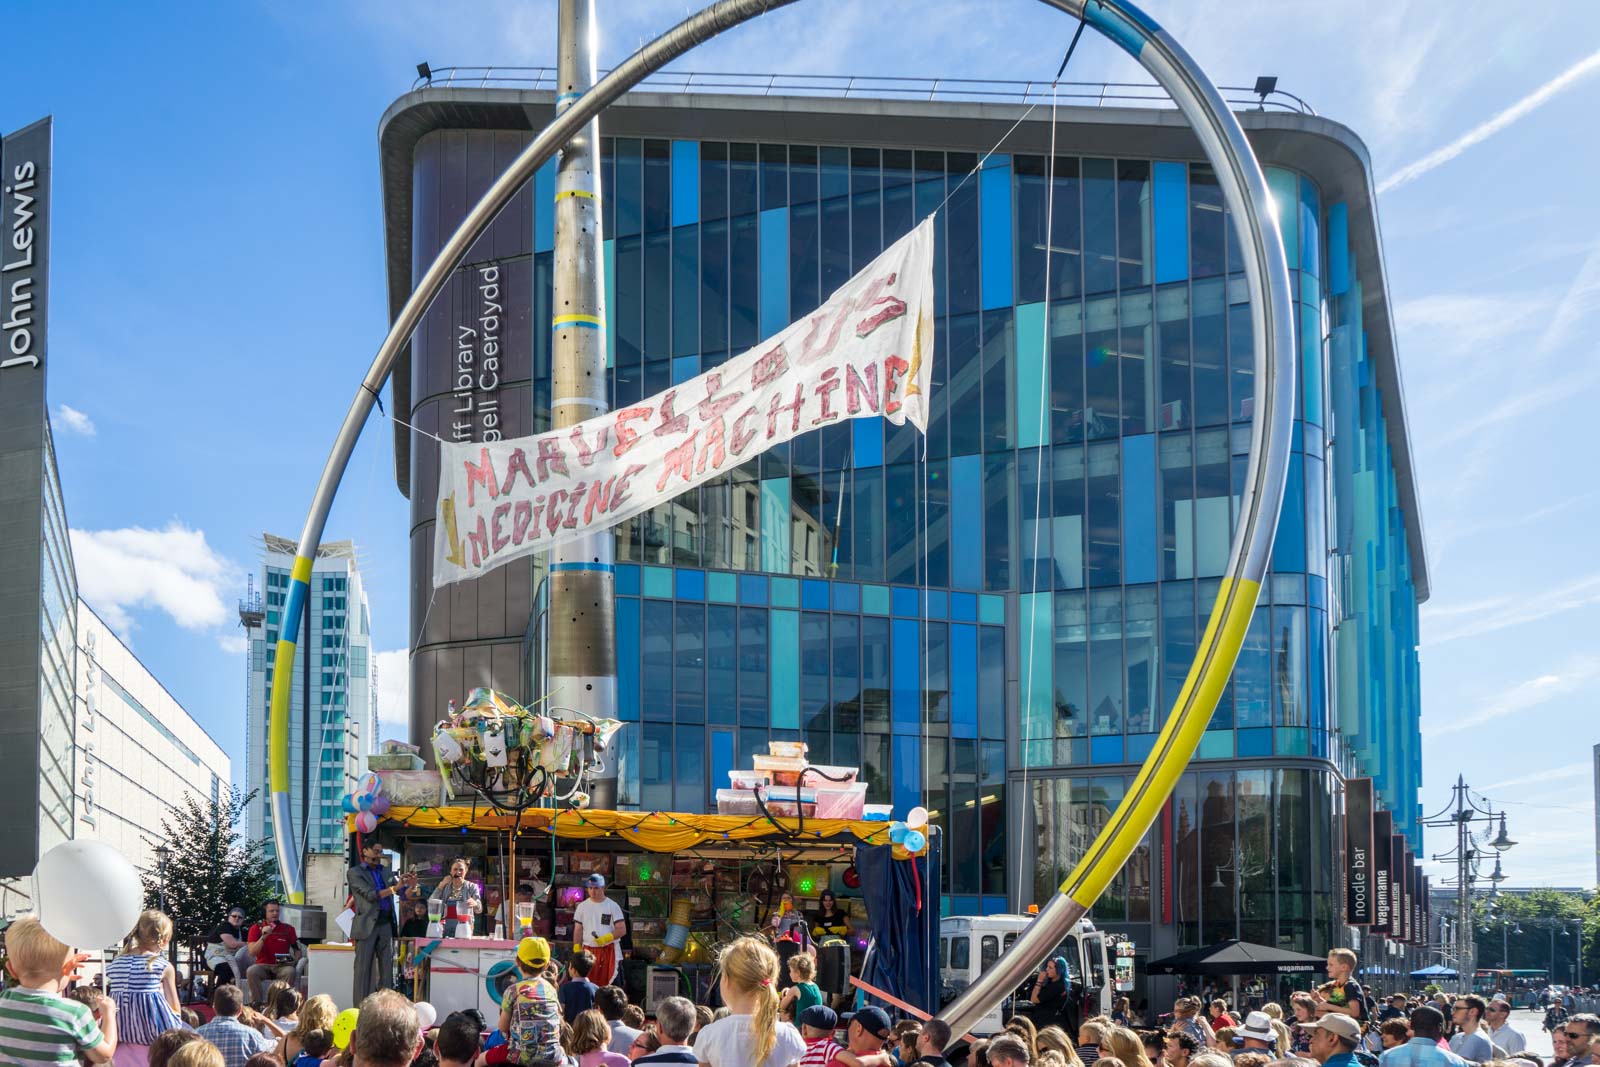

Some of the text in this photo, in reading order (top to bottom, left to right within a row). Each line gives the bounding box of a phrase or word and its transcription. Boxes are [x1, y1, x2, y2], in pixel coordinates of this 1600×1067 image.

[0, 160, 39, 367] John Lewis
[453, 325, 477, 413] Library
[479, 266, 502, 391] Caerdydd
[1352, 847, 1366, 917] noodle bar
[1377, 870, 1390, 926] wagamama
